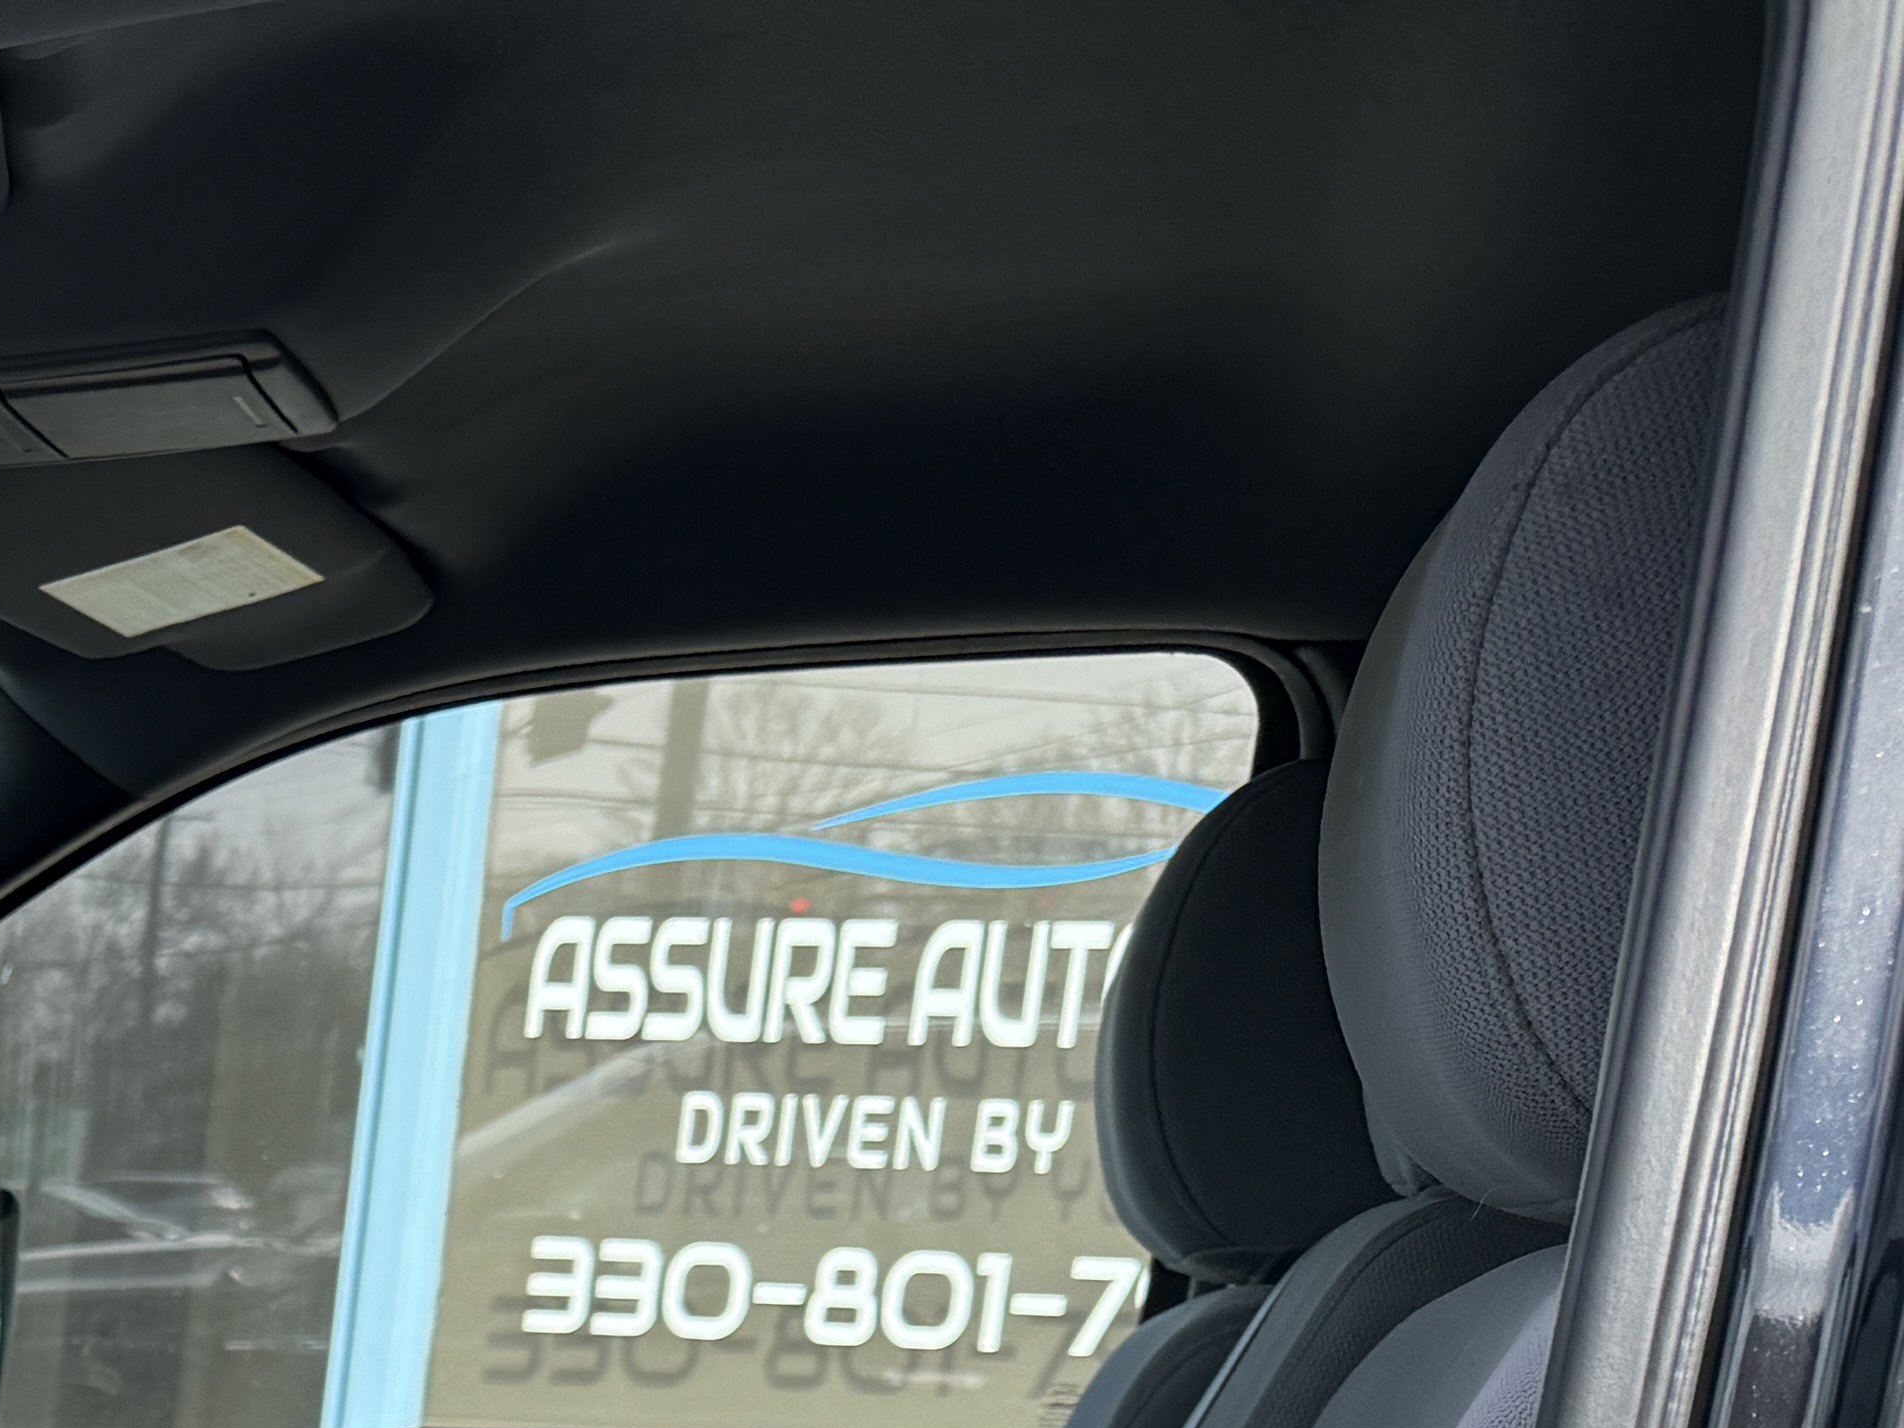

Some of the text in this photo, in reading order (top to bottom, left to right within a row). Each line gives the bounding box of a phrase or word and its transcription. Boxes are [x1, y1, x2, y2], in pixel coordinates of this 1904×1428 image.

[523, 916, 1134, 1049] ASSURE AUT
[676, 1091, 1074, 1175] DRIVEN BY
[521, 1235, 1151, 1357] 330-801-7
